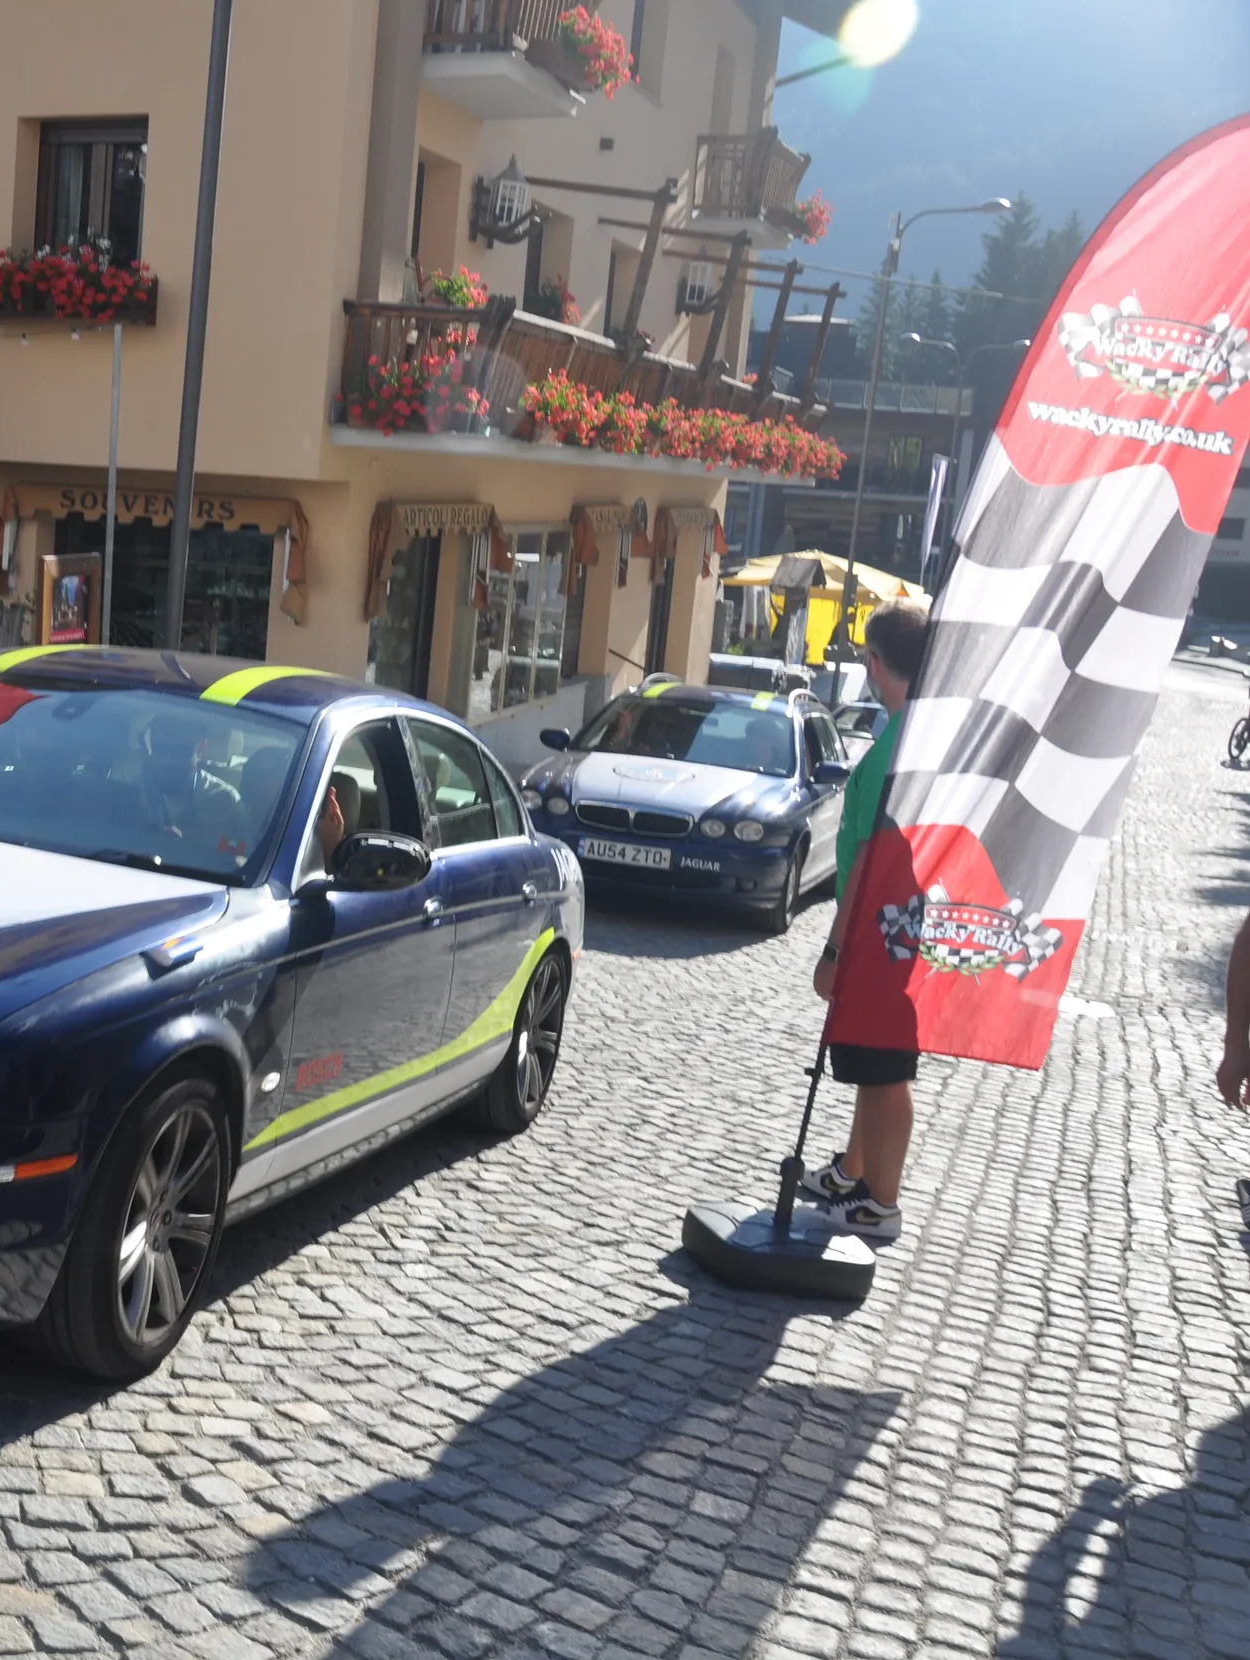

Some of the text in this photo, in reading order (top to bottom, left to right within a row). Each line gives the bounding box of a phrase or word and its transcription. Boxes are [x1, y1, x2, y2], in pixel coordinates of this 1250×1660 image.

[1027, 401, 1233, 455] wackyrally.co.uk
[59, 489, 236, 521] SOVENRS
[451, 506, 489, 525] REGALO
[586, 840, 627, 861] AU54
[680, 856, 721, 873] JAGUAR
[972, 926, 1023, 956] Rally
